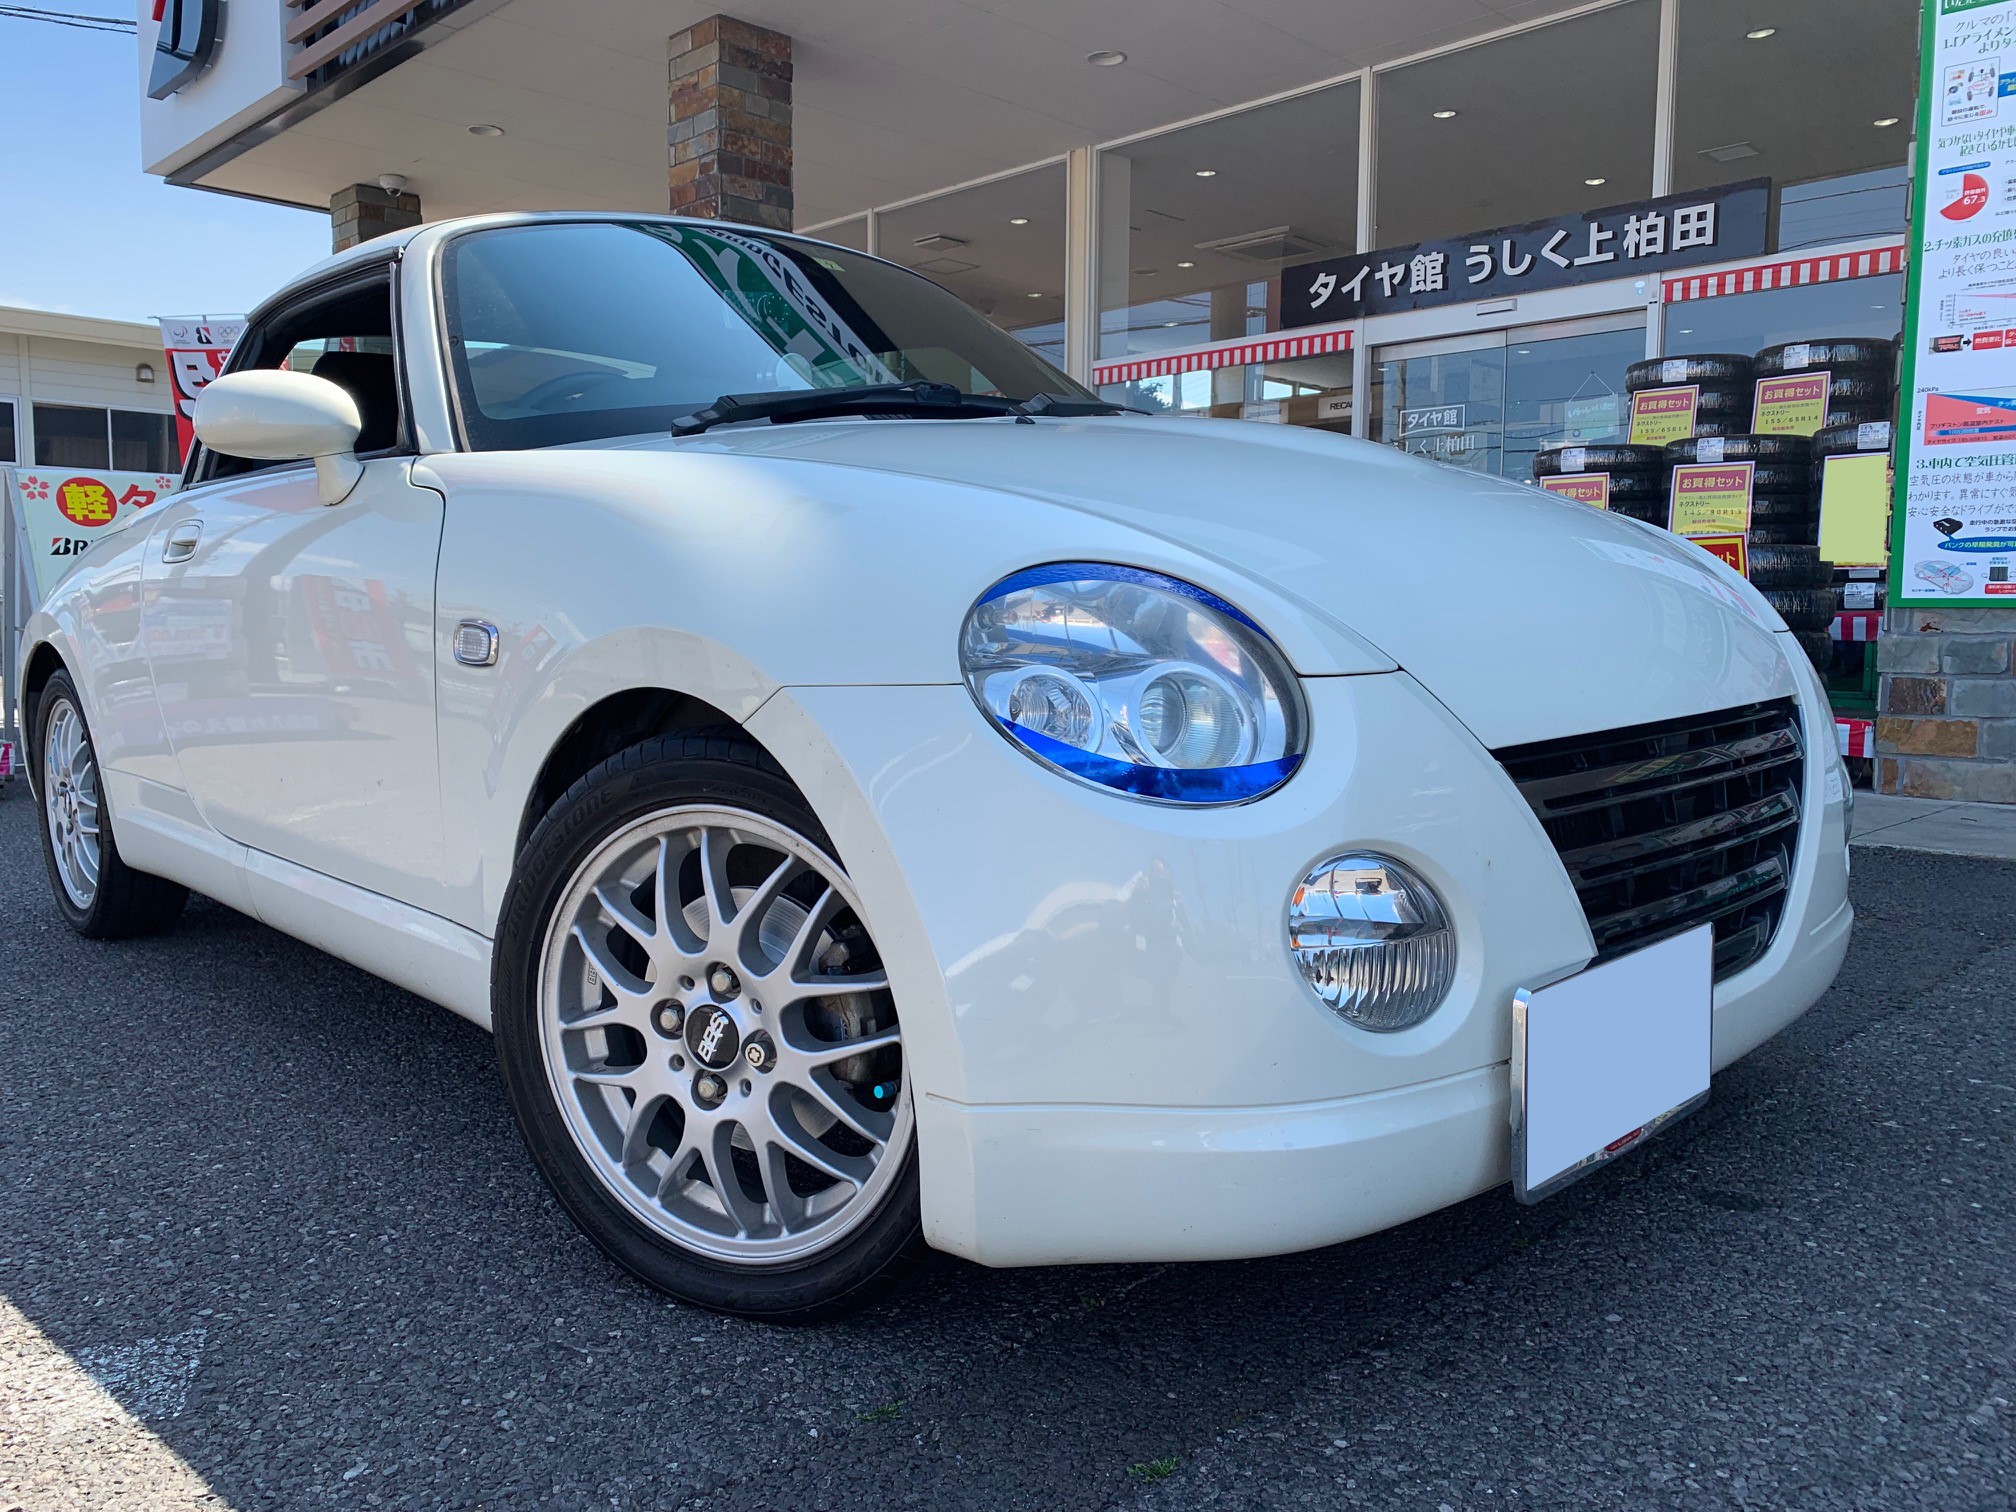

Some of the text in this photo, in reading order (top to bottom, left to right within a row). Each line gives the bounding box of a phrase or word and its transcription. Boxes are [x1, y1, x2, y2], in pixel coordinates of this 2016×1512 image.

[1963, 195, 1986, 205] 67.3
[1309, 202, 1716, 309] タイヤ館 うしく上柏田
[1938, 260, 2016, 279] より長く保つこと
[1763, 385, 1820, 400] お買得セット
[1330, 402, 1352, 411] RECA
[1639, 398, 1690, 411] お買得セット
[1407, 409, 1458, 428] タイヤ館
[1761, 409, 1790, 417] ネクストリー
[1916, 454, 2016, 469] 3.車内で空気圧管
[1682, 475, 1743, 489] お買得セット
[1909, 471, 2016, 487] 空気圧の状態が車から
[50, 537, 95, 556] BR
[697, 1010, 729, 1063] BBS
